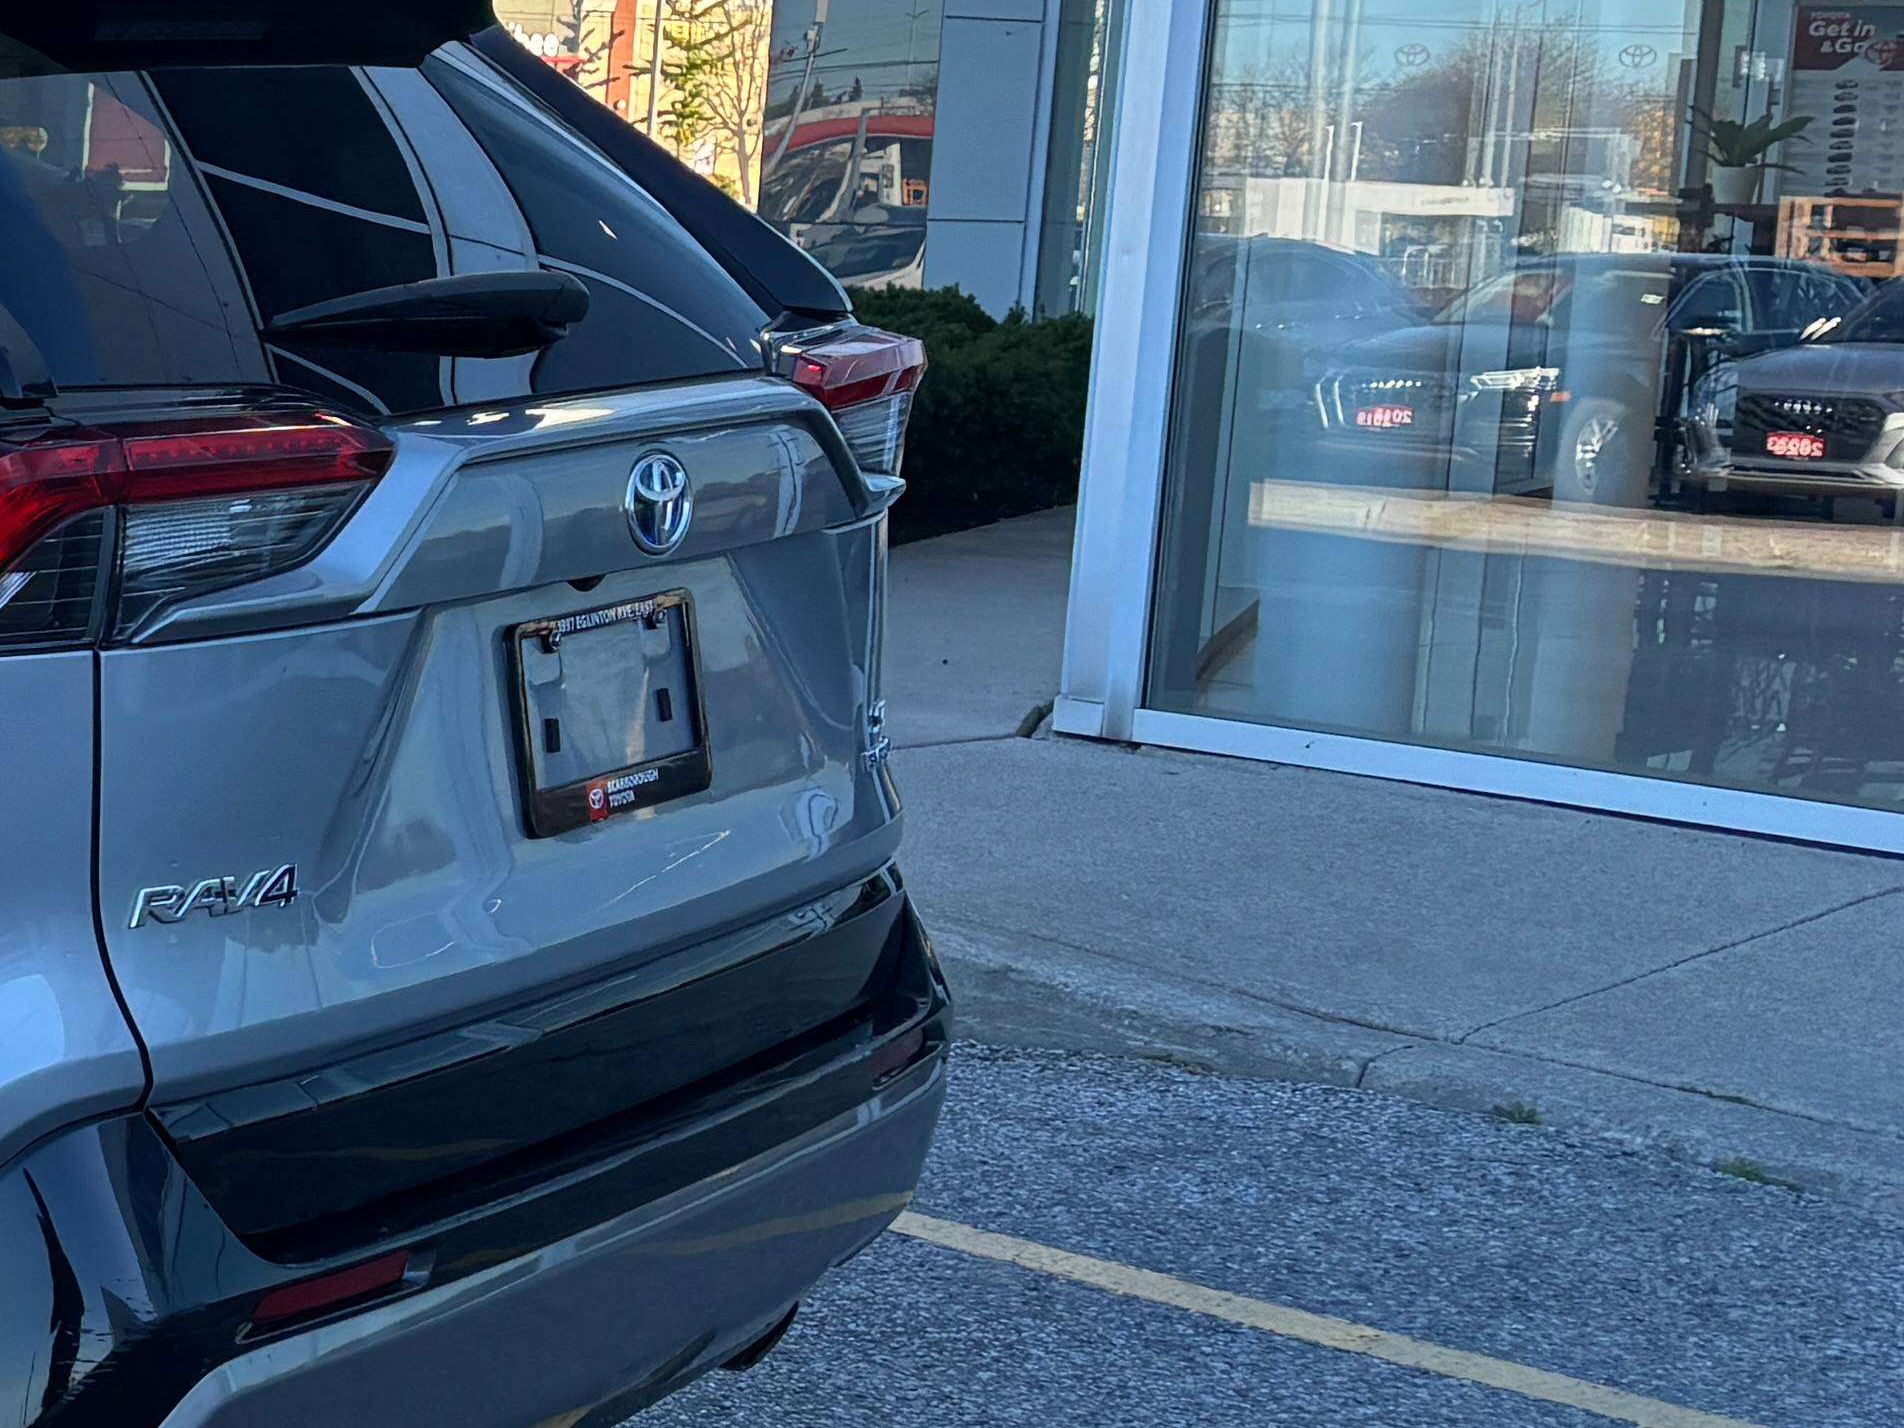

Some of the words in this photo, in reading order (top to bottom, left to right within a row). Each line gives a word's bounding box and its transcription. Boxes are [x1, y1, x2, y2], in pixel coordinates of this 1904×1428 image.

[1809, 20, 1851, 37] Get
[1854, 19, 1876, 37] in
[129, 863, 298, 929] RAV4
